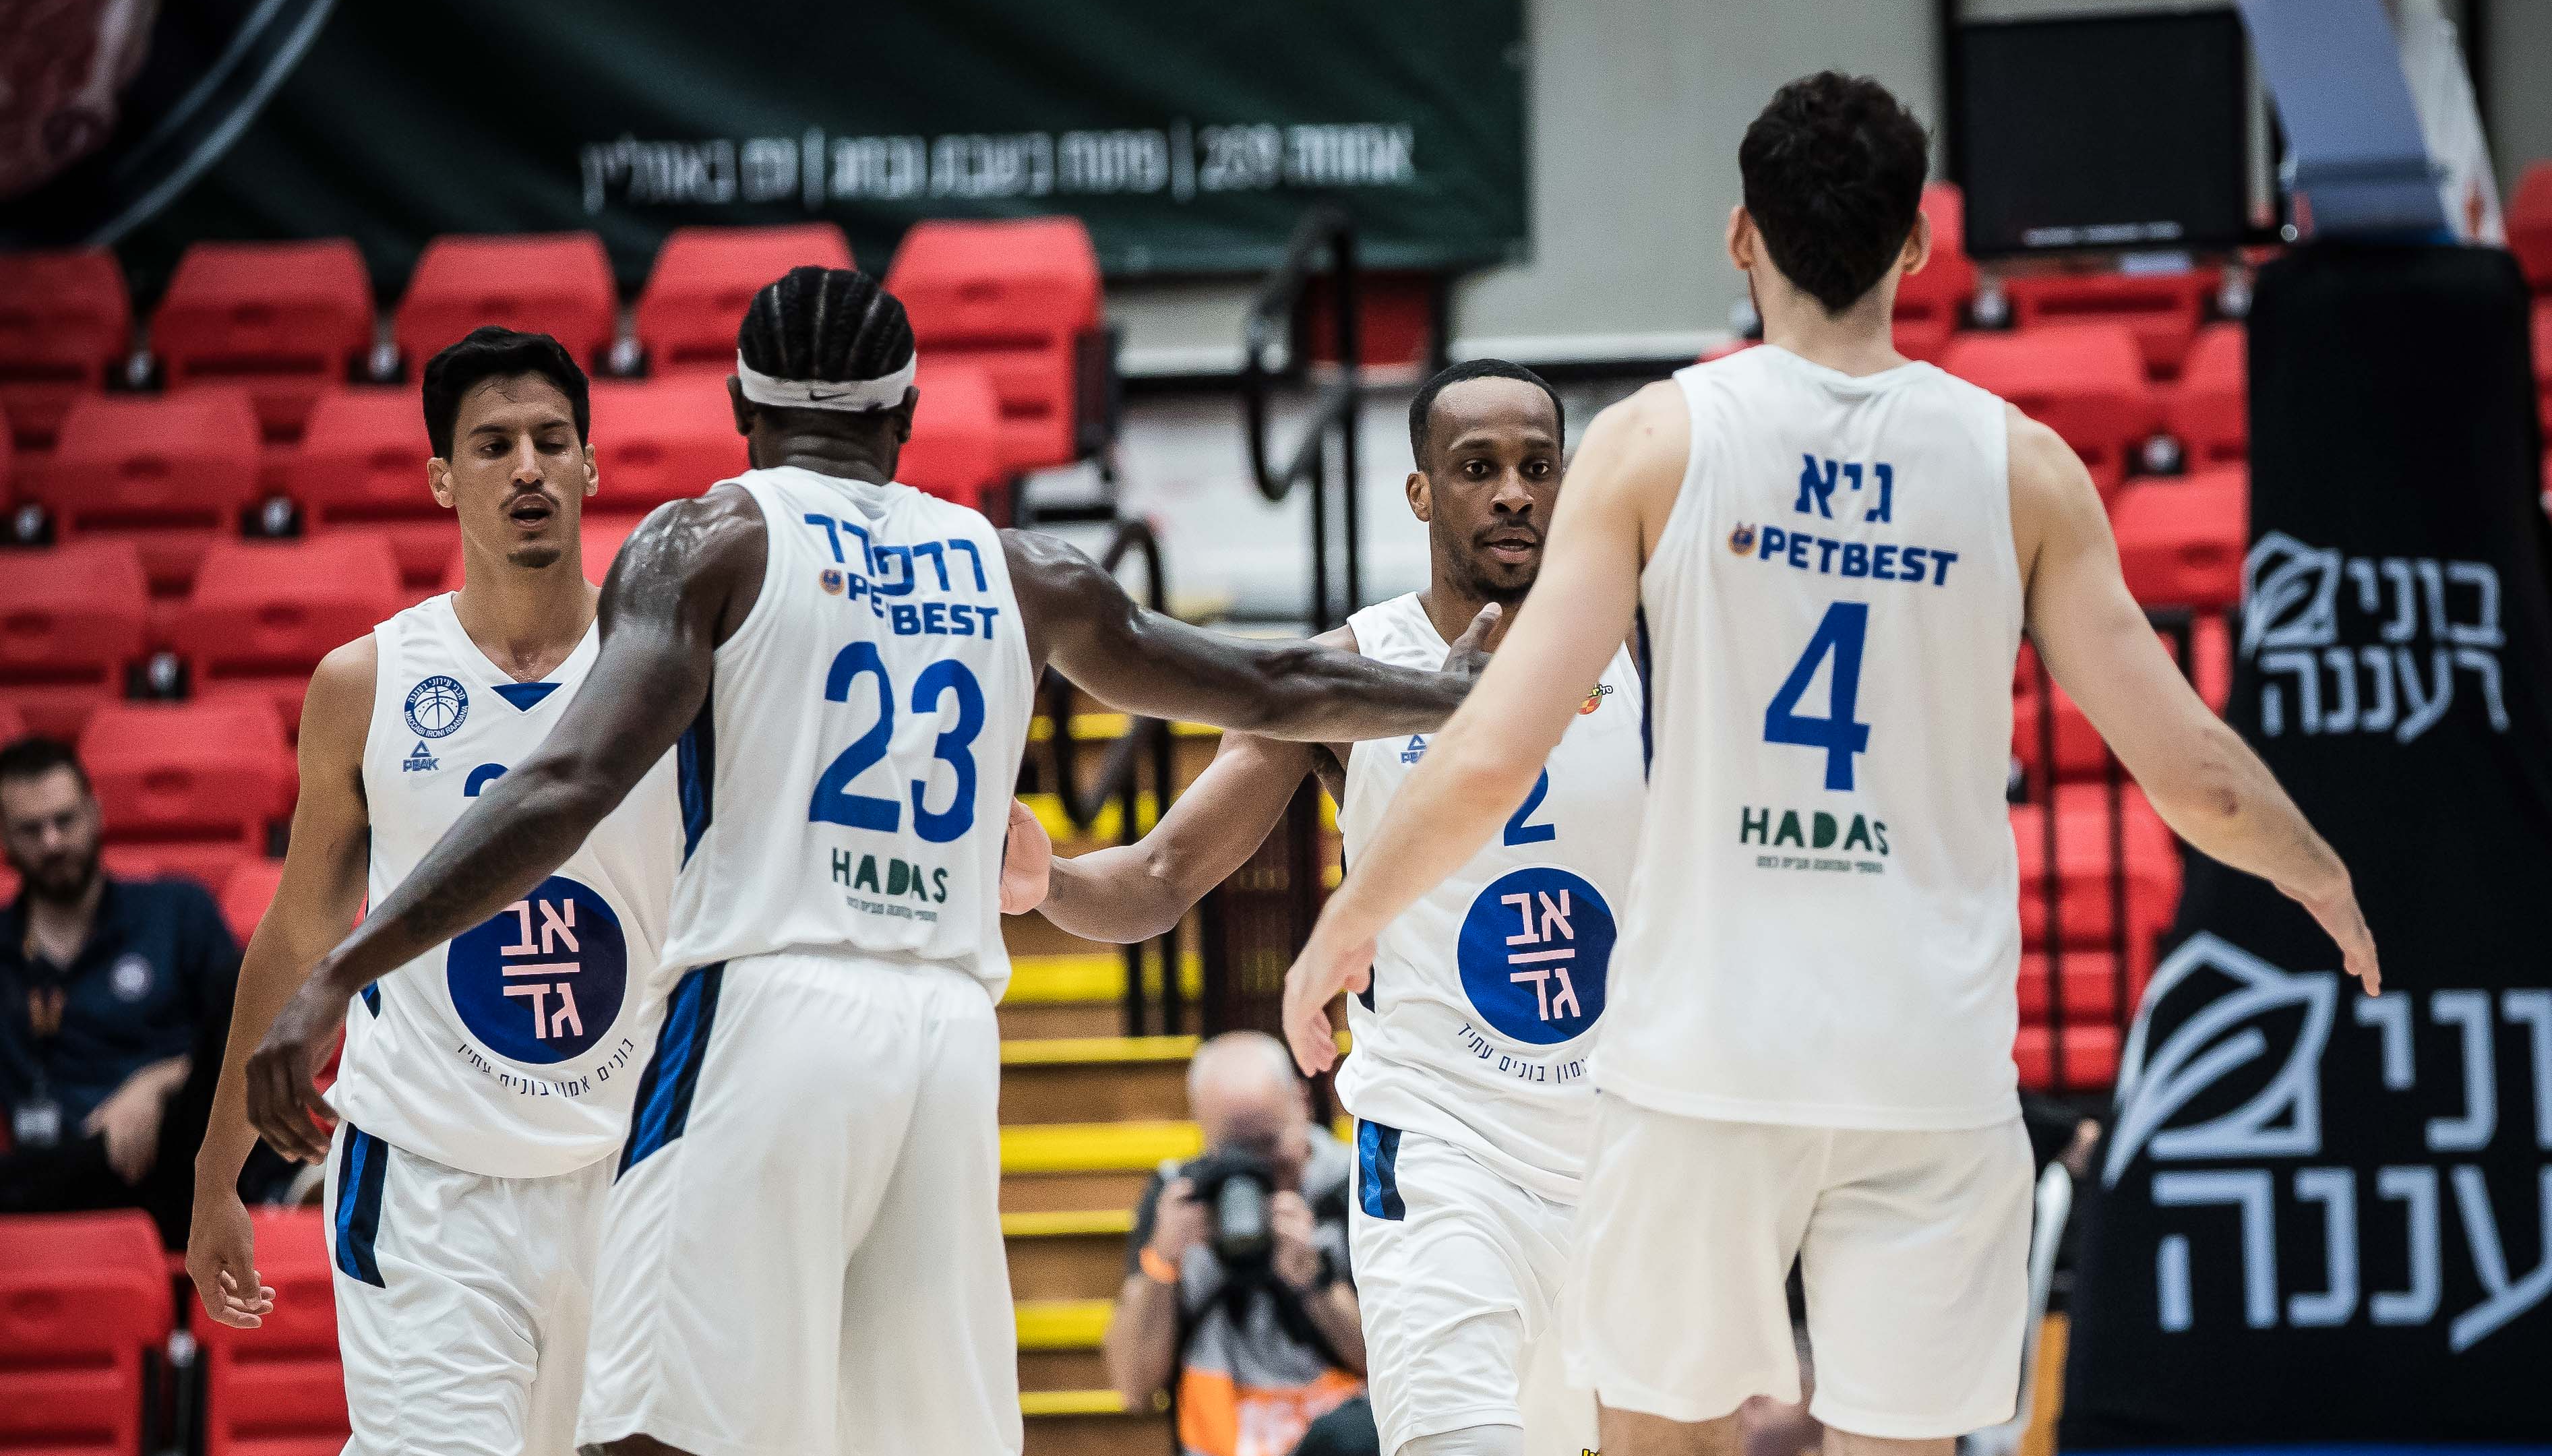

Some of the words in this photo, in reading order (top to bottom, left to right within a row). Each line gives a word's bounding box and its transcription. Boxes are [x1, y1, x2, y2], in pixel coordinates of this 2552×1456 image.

[1795, 454, 1893, 523] גיא
[1759, 525, 1958, 586] PETBEST
[848, 572, 999, 640] PEBEST
[2346, 557, 2505, 647] בוני
[404, 710, 426, 735] MACCABI
[426, 729, 446, 737] IRONI
[446, 705, 468, 734] RAANANA
[1763, 601, 1871, 793] 4
[2258, 645, 2510, 741] רעננה
[402, 758, 439, 772] PEAK
[809, 641, 985, 843] 23
[1740, 806, 1889, 856] HADAS
[831, 847, 948, 904] HADAS
[501, 899, 579, 956] אב
[1501, 888, 1574, 946] אב
[503, 982, 583, 1039] גד
[1510, 967, 1581, 1022] גד
[597, 1038, 634, 1081] בונים
[1458, 1023, 1494, 1059] עתיד
[1499, 1056, 1544, 1082] בונים
